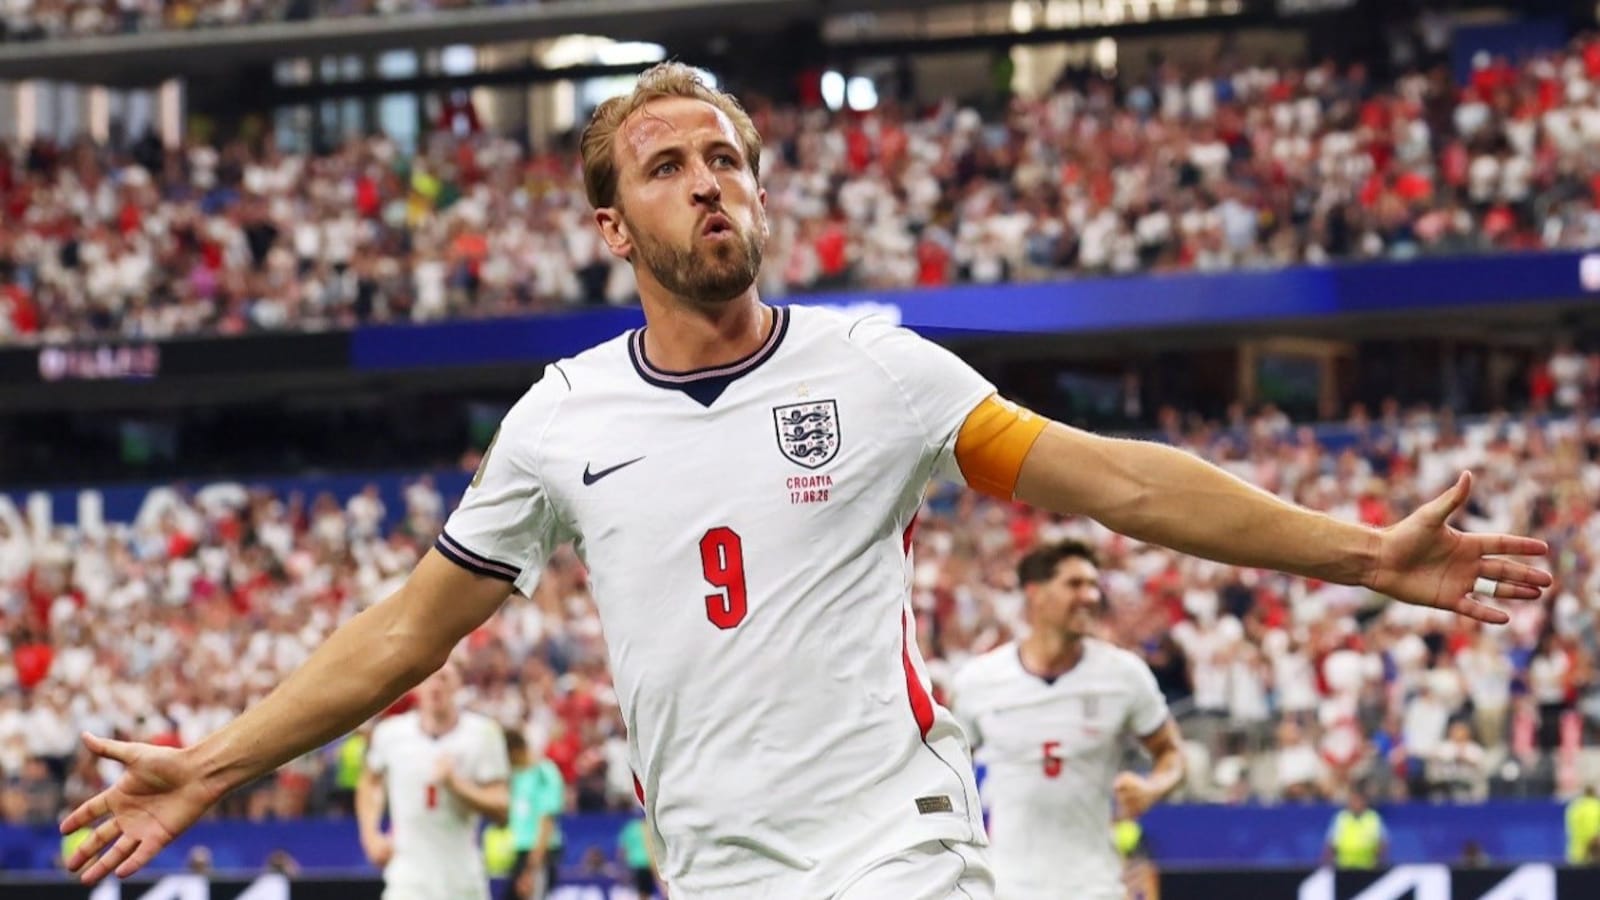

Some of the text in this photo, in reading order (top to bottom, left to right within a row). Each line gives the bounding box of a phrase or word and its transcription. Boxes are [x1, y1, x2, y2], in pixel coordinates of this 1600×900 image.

[786, 475, 833, 489] CROATIA
[790, 489, 829, 504] 17.06.26
[699, 526, 747, 630] 9
[1042, 740, 1062, 778] 5
